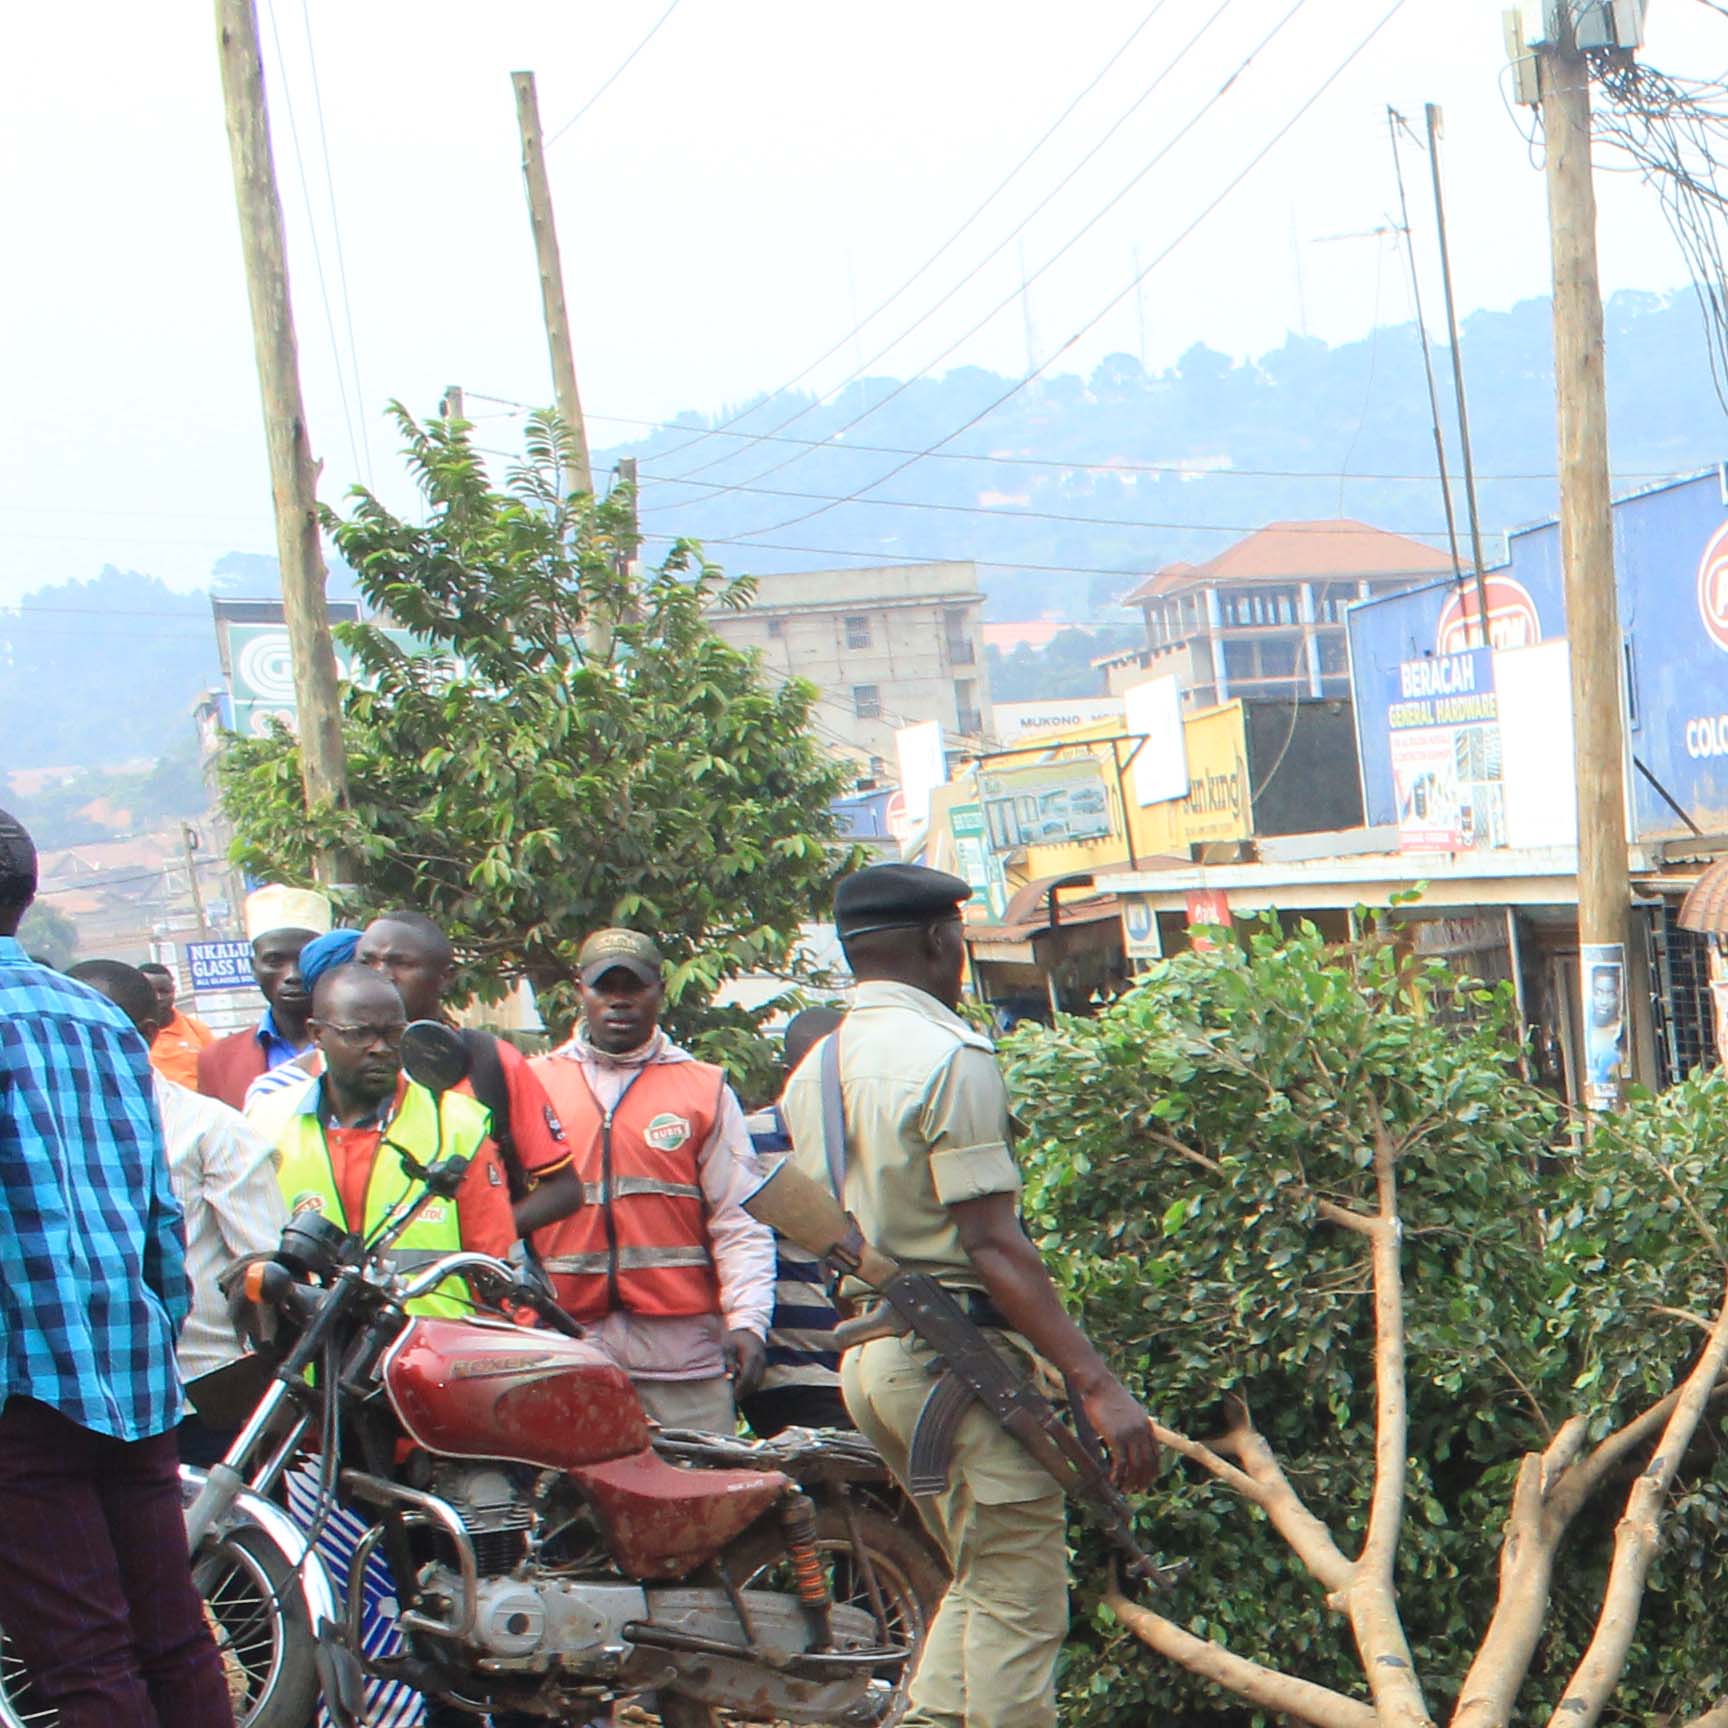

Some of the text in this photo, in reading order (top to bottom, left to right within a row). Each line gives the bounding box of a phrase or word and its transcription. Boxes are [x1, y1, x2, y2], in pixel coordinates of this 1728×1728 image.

[1401, 654, 1475, 698] BERACAH
[1436, 692, 1497, 724] HARDWARE
[190, 942, 255, 960] NKALU
[193, 960, 235, 977] GLASS
